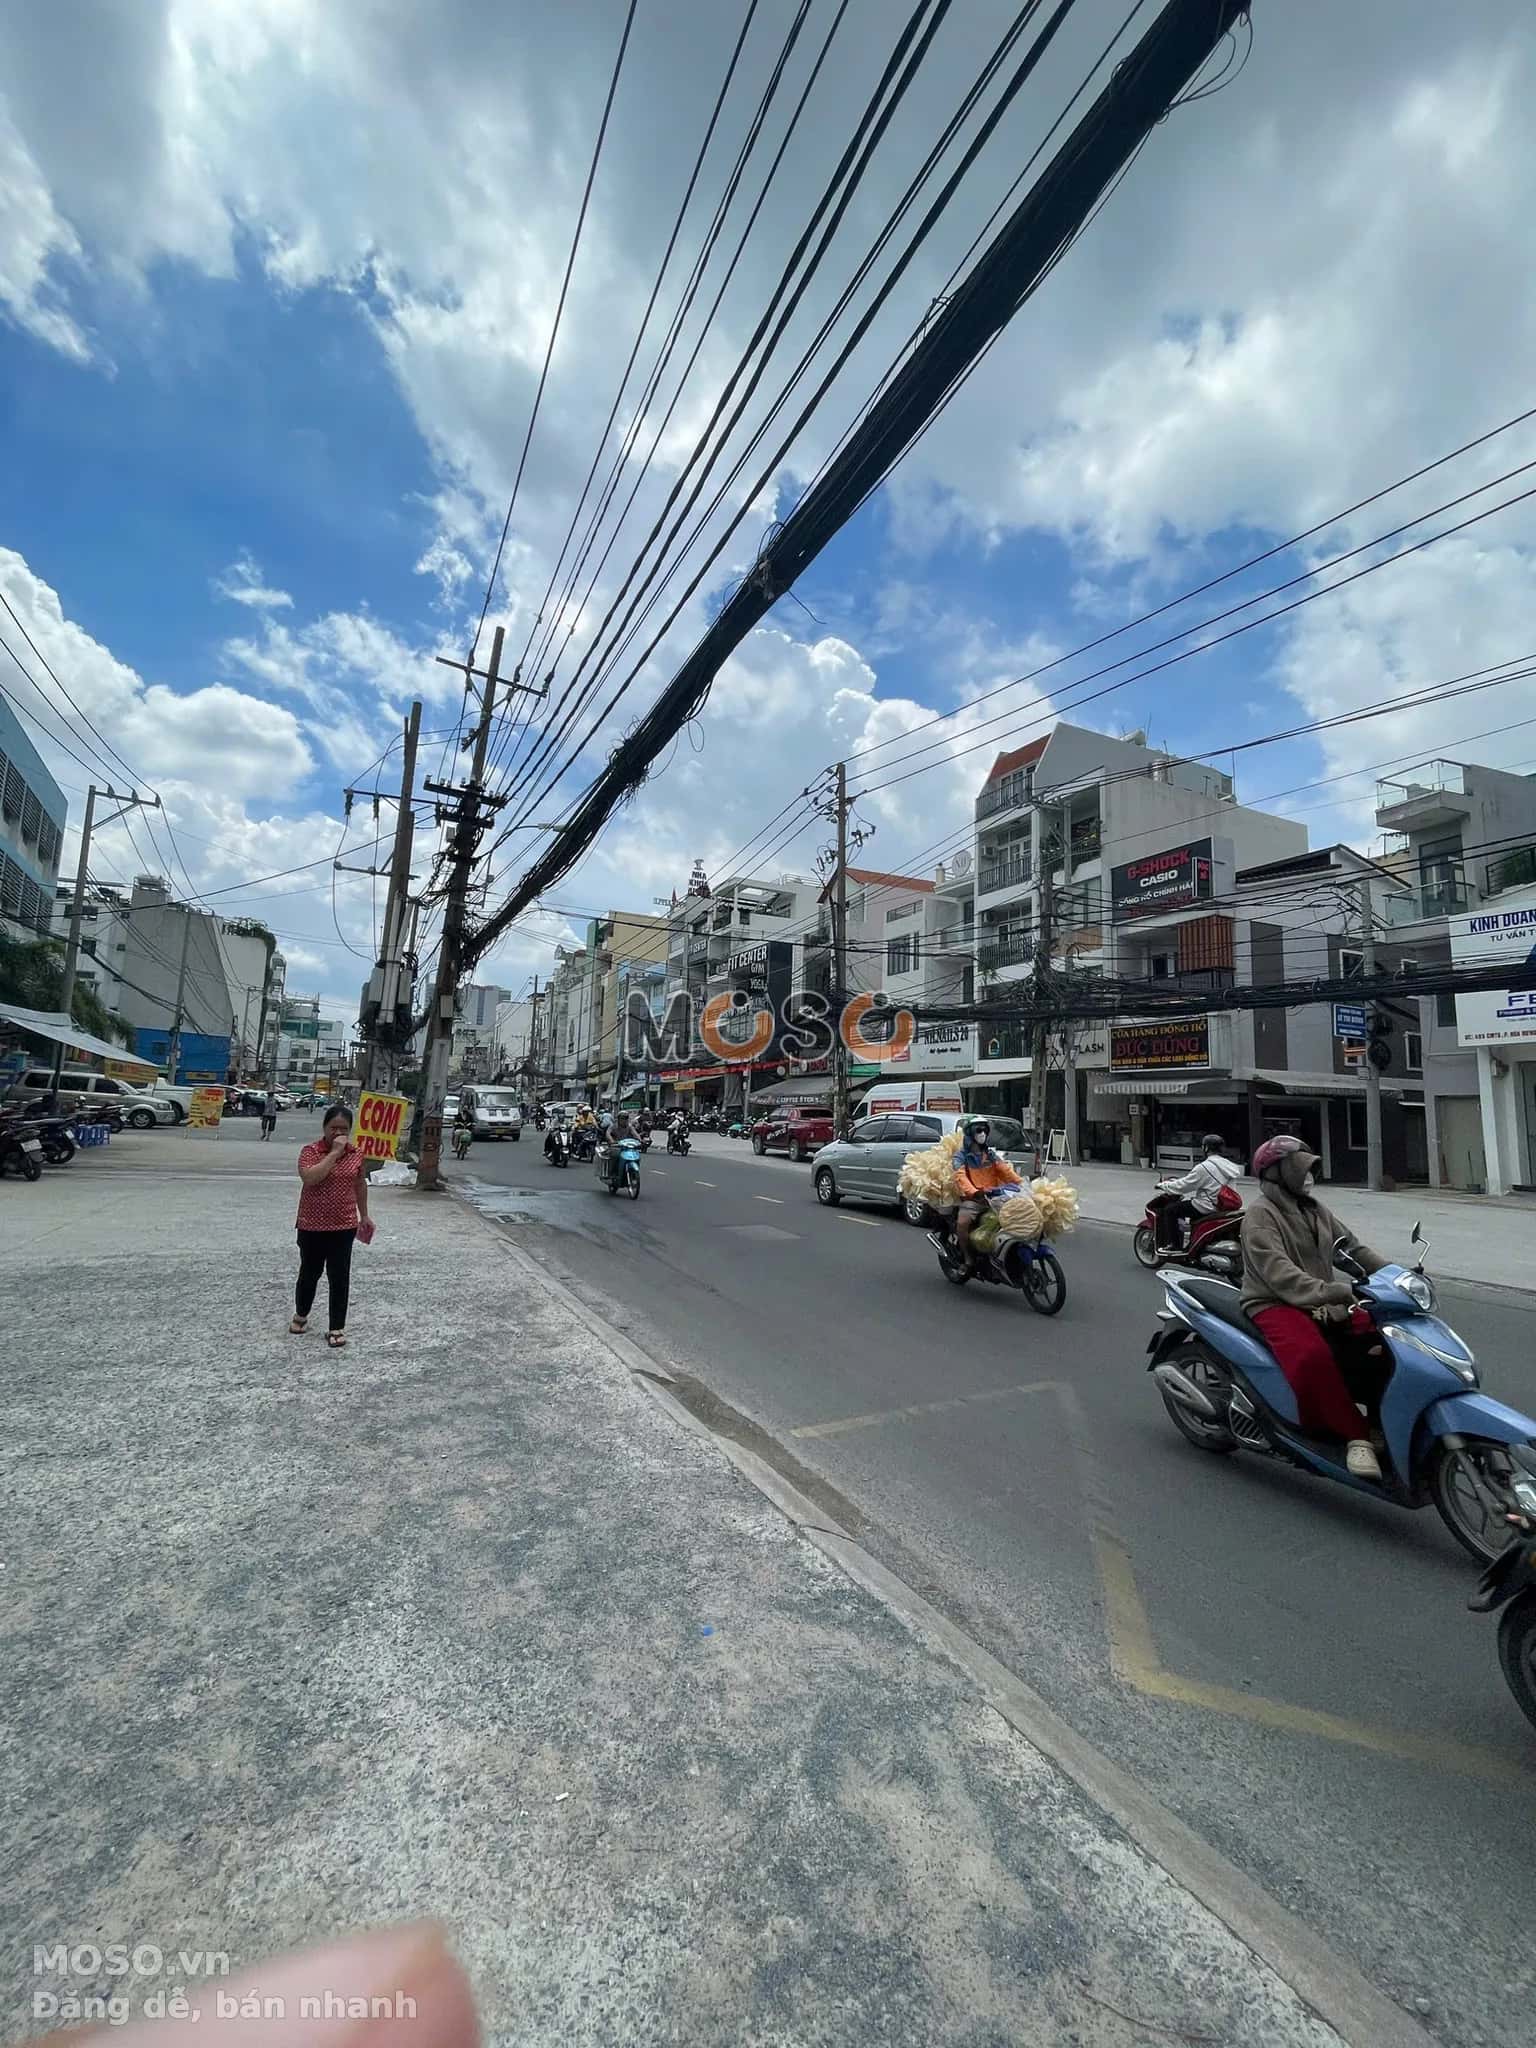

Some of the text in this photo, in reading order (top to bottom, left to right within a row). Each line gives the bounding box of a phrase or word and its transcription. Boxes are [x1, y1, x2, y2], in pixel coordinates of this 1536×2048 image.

[1127, 849, 1191, 880] G-SHOCK
[1140, 869, 1178, 888] CASIO
[1470, 915, 1499, 933] KINH
[728, 944, 768, 972] FIT CENTER
